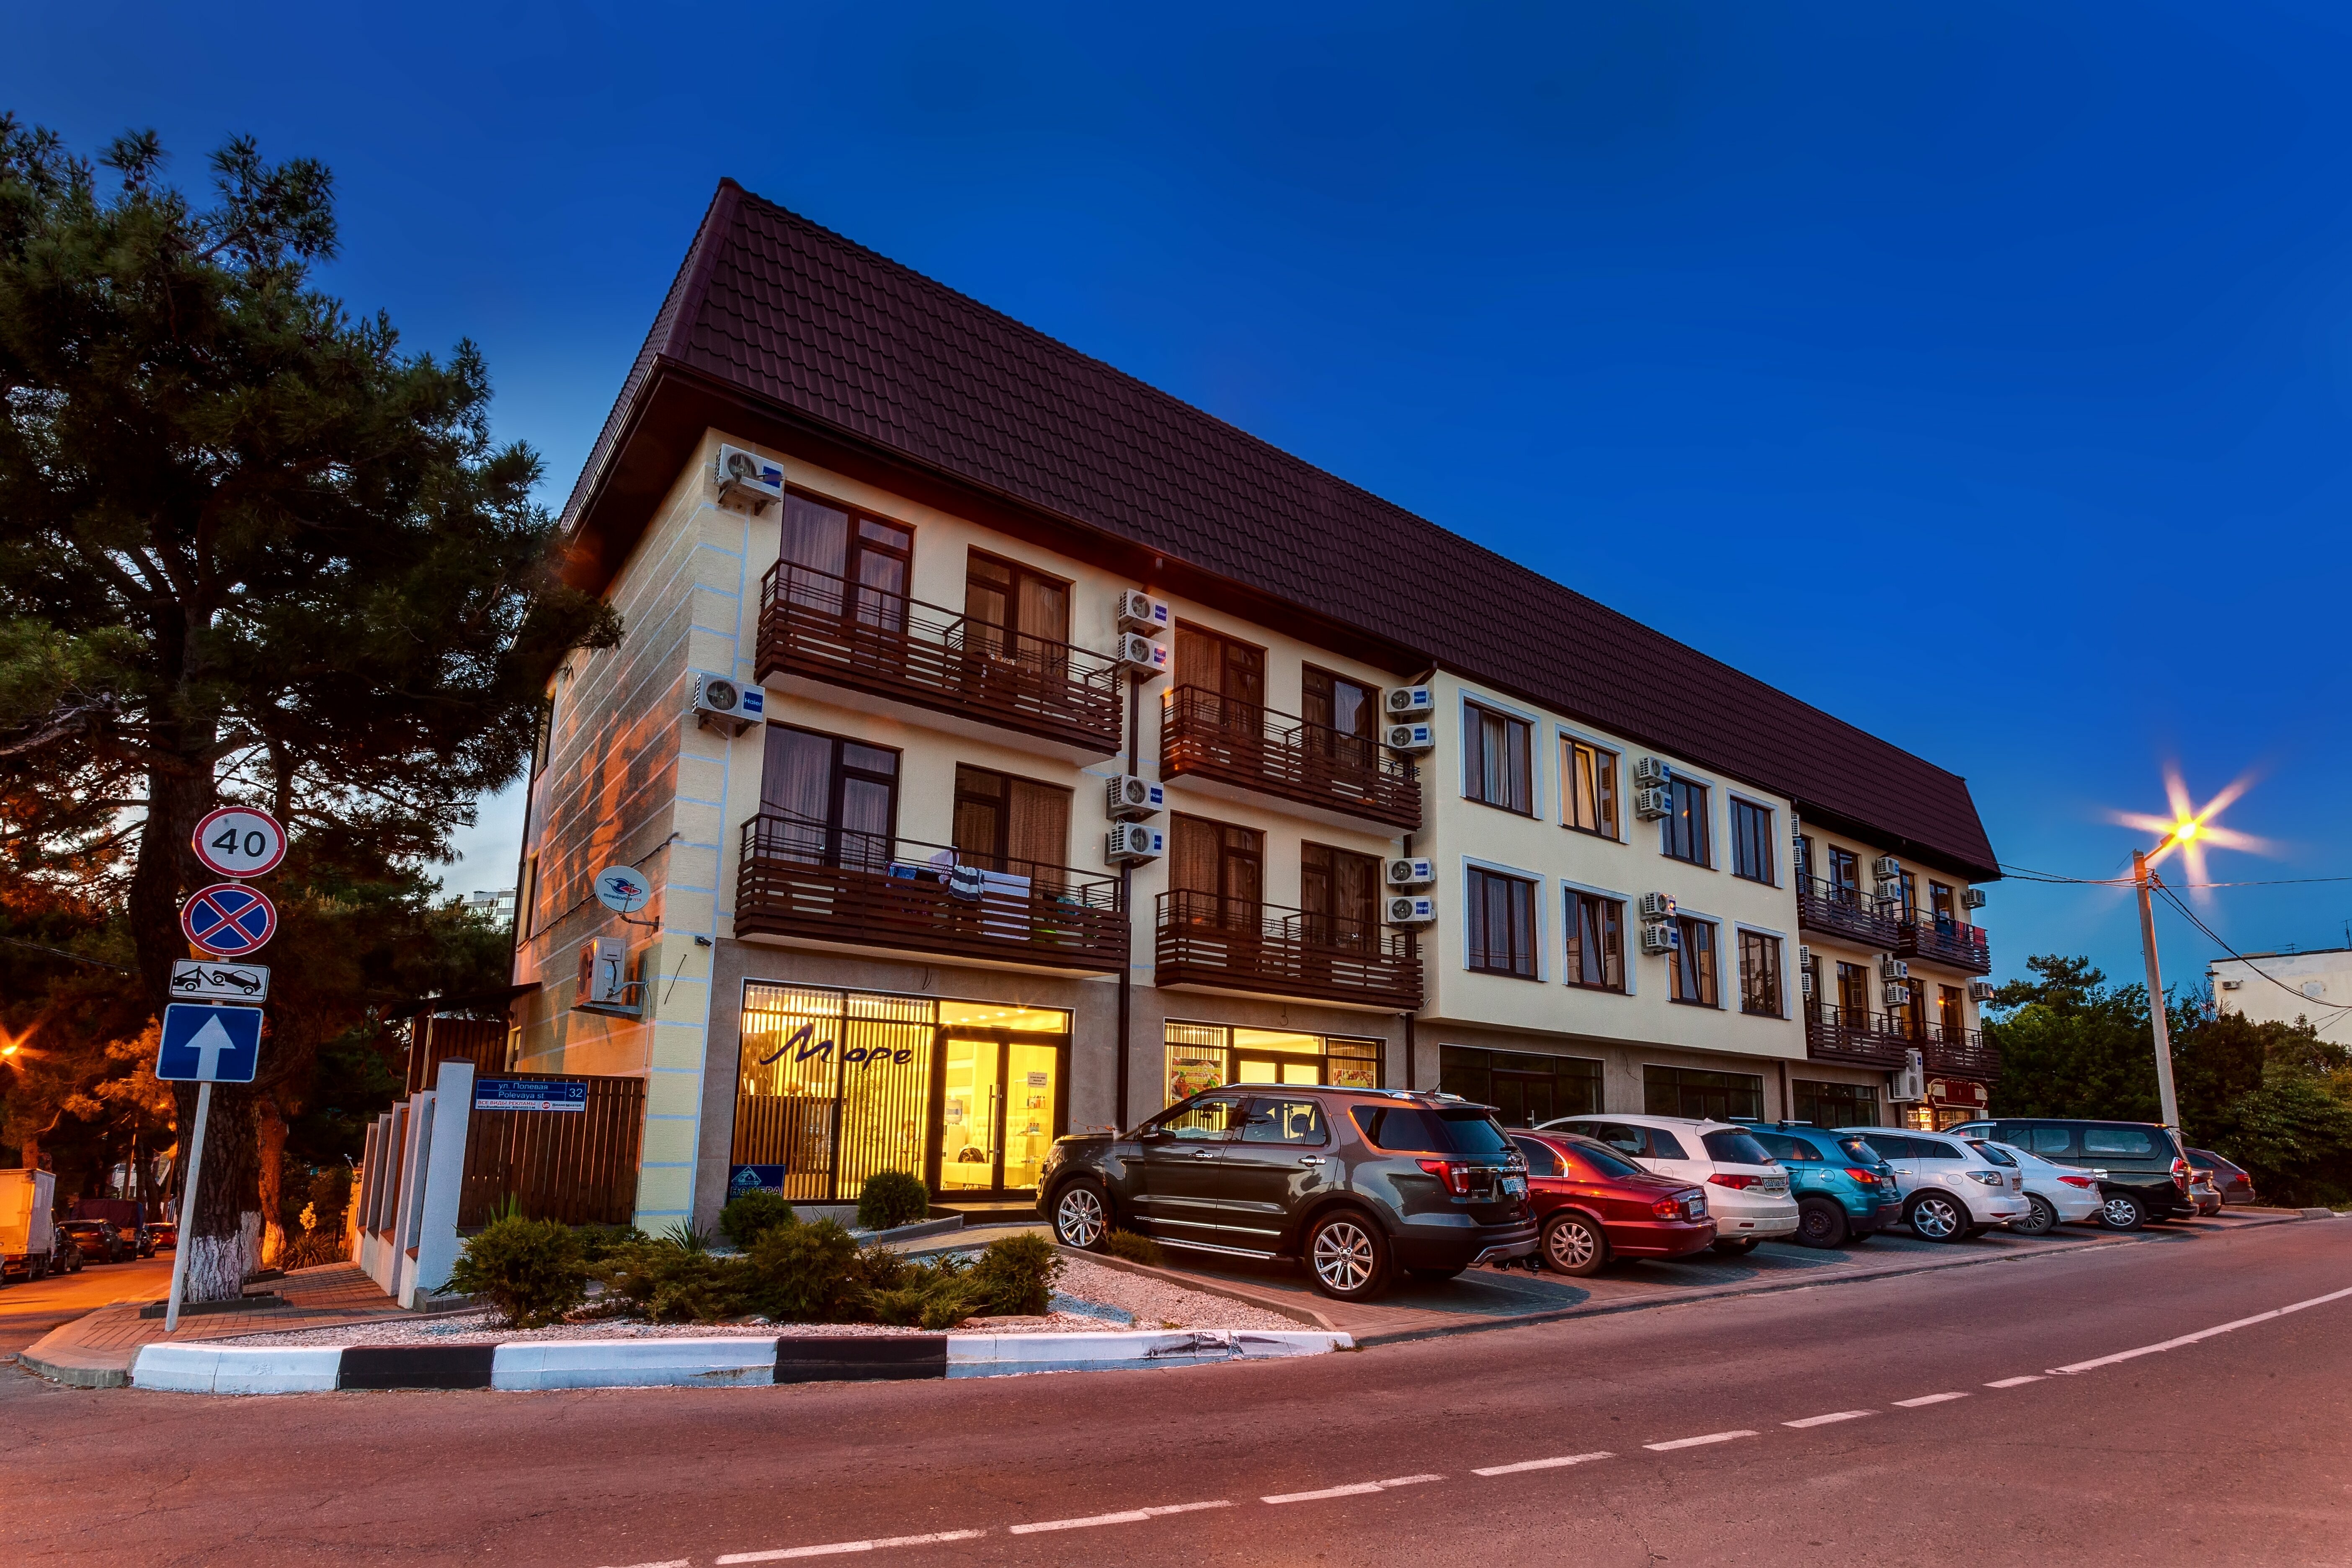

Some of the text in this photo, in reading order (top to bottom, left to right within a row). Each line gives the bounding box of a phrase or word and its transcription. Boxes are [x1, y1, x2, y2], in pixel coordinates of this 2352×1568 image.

[212, 828, 266, 857] 40
[759, 1023, 911, 1071] Море
[569, 1088, 582, 1097] 32
